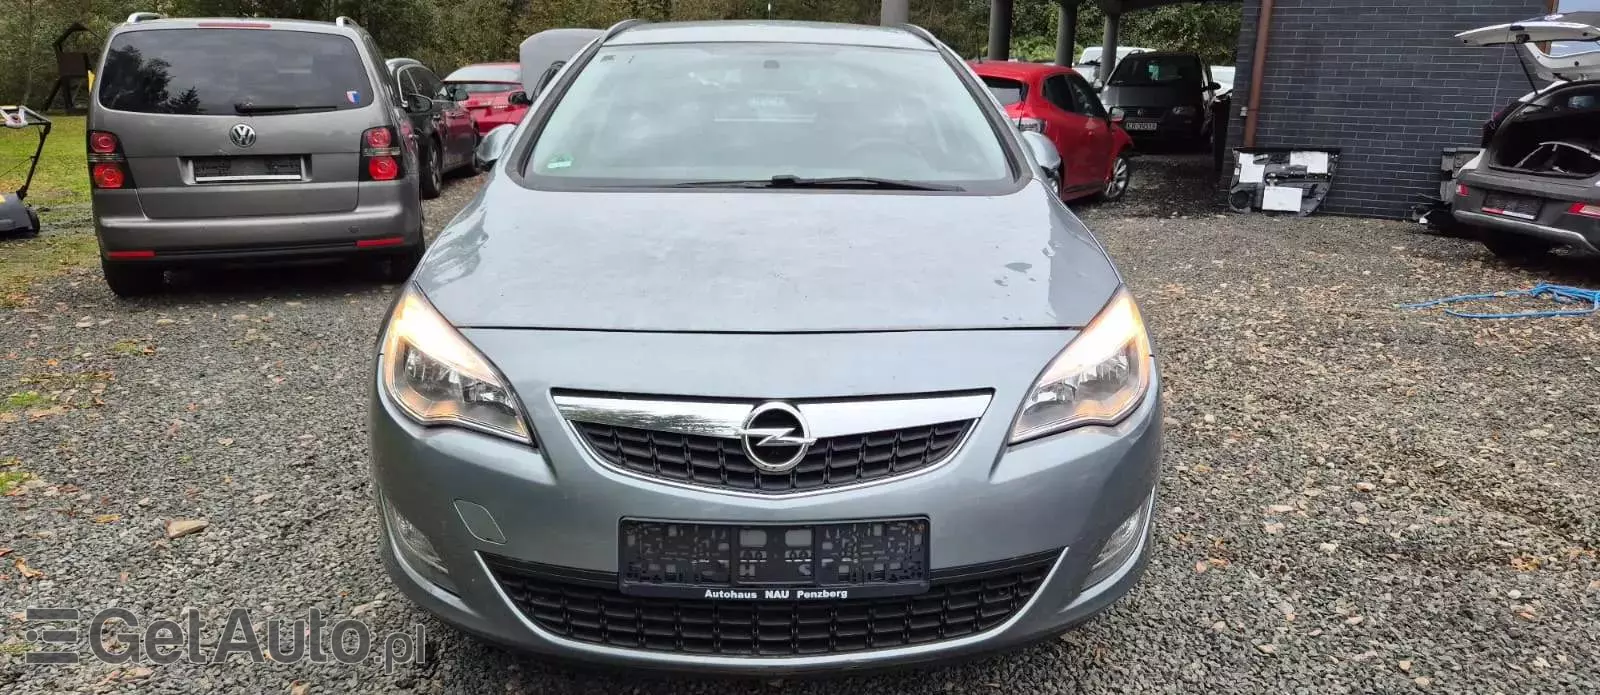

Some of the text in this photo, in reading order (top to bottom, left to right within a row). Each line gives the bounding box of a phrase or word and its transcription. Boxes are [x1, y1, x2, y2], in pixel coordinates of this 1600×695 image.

[705, 589, 848, 599] Autohaus NAU Penzberg
